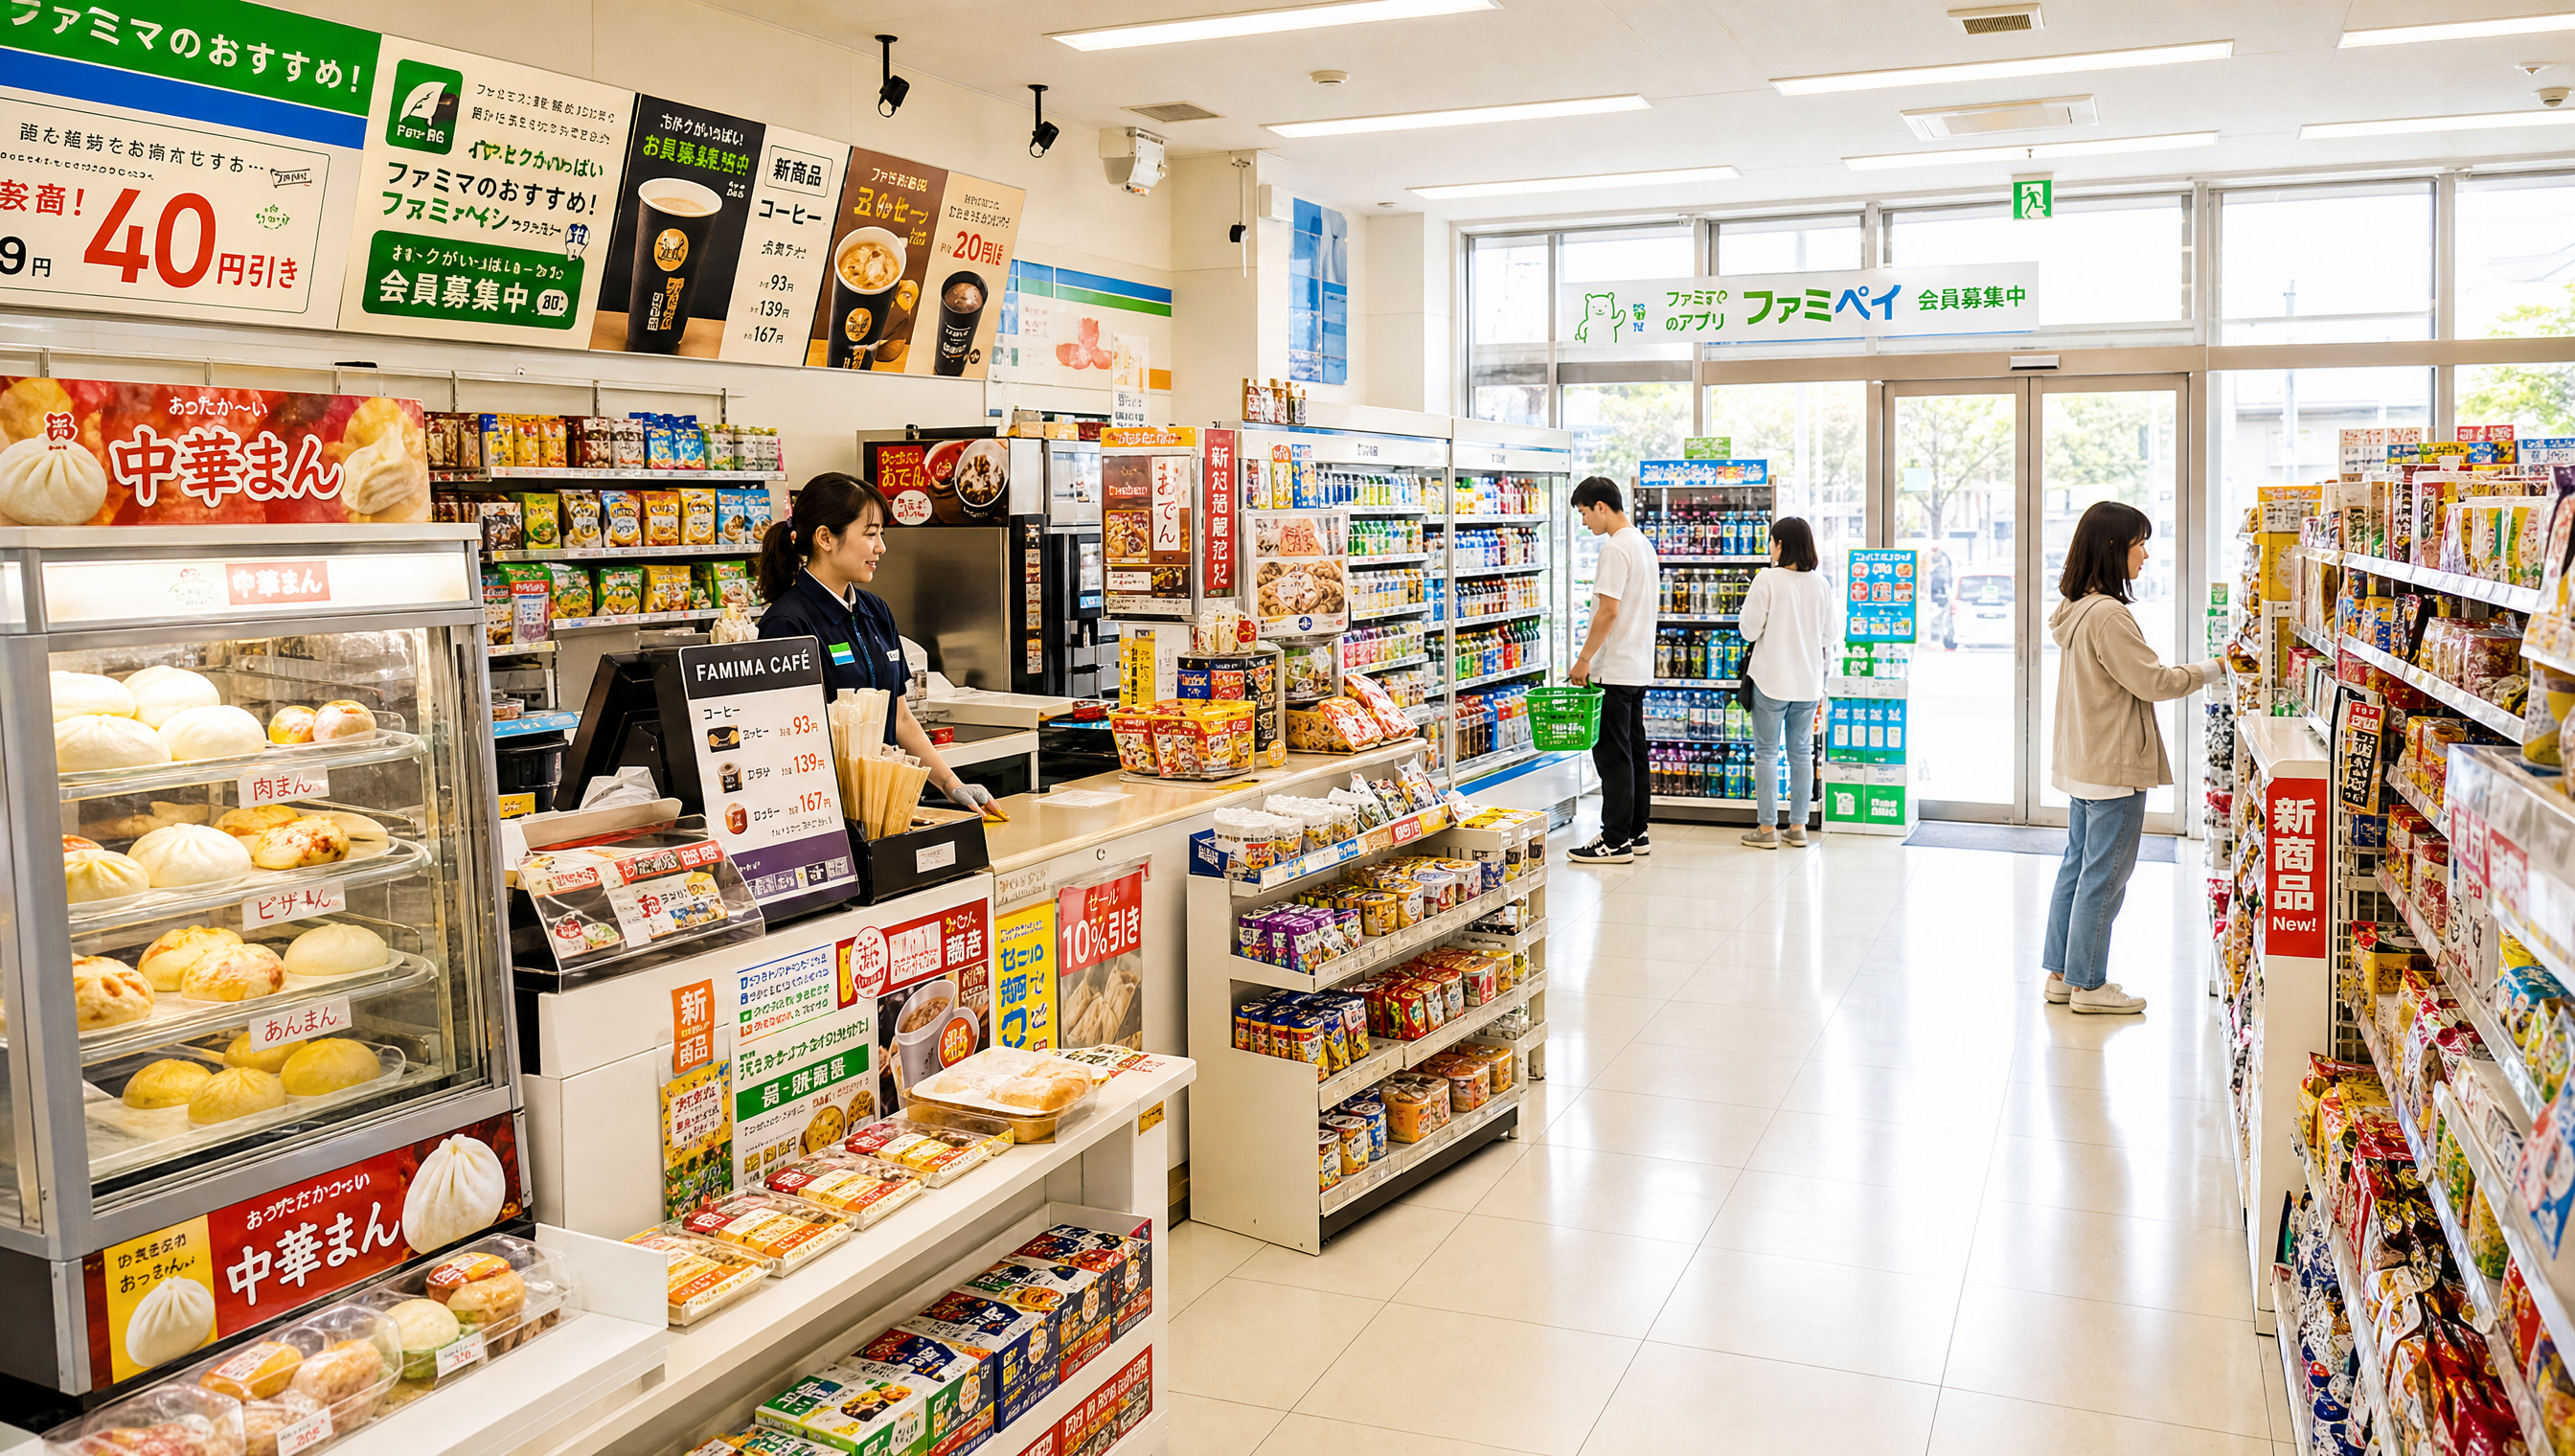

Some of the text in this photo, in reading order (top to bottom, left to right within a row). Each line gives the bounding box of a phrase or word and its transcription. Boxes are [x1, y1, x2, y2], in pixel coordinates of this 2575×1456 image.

[11, 0, 360, 93] ファミマのおすすめ!
[388, 161, 597, 216] ファミマのおすすめ!
[772, 157, 822, 187] 新商品
[758, 198, 822, 225] コーヒー
[83, 187, 298, 289] 40円引き
[379, 269, 529, 313] 会員募集中
[1743, 284, 2026, 325] ファミペイ 会員募集中
[1665, 311, 1724, 331] のアプリ
[111, 426, 343, 507] 中華まん
[1157, 472, 1176, 543] おでん
[232, 568, 323, 599] 中華まん
[695, 648, 811, 682] FAMIMA CAFÉ
[703, 706, 741, 720] コーヒー
[253, 774, 312, 801] 肉まん
[2273, 797, 2316, 911] 新商品
[1088, 887, 1119, 911] セール
[2272, 916, 2317, 932] New!
[264, 1007, 337, 1042] あんまん
[226, 1201, 400, 1307] 中華まん
